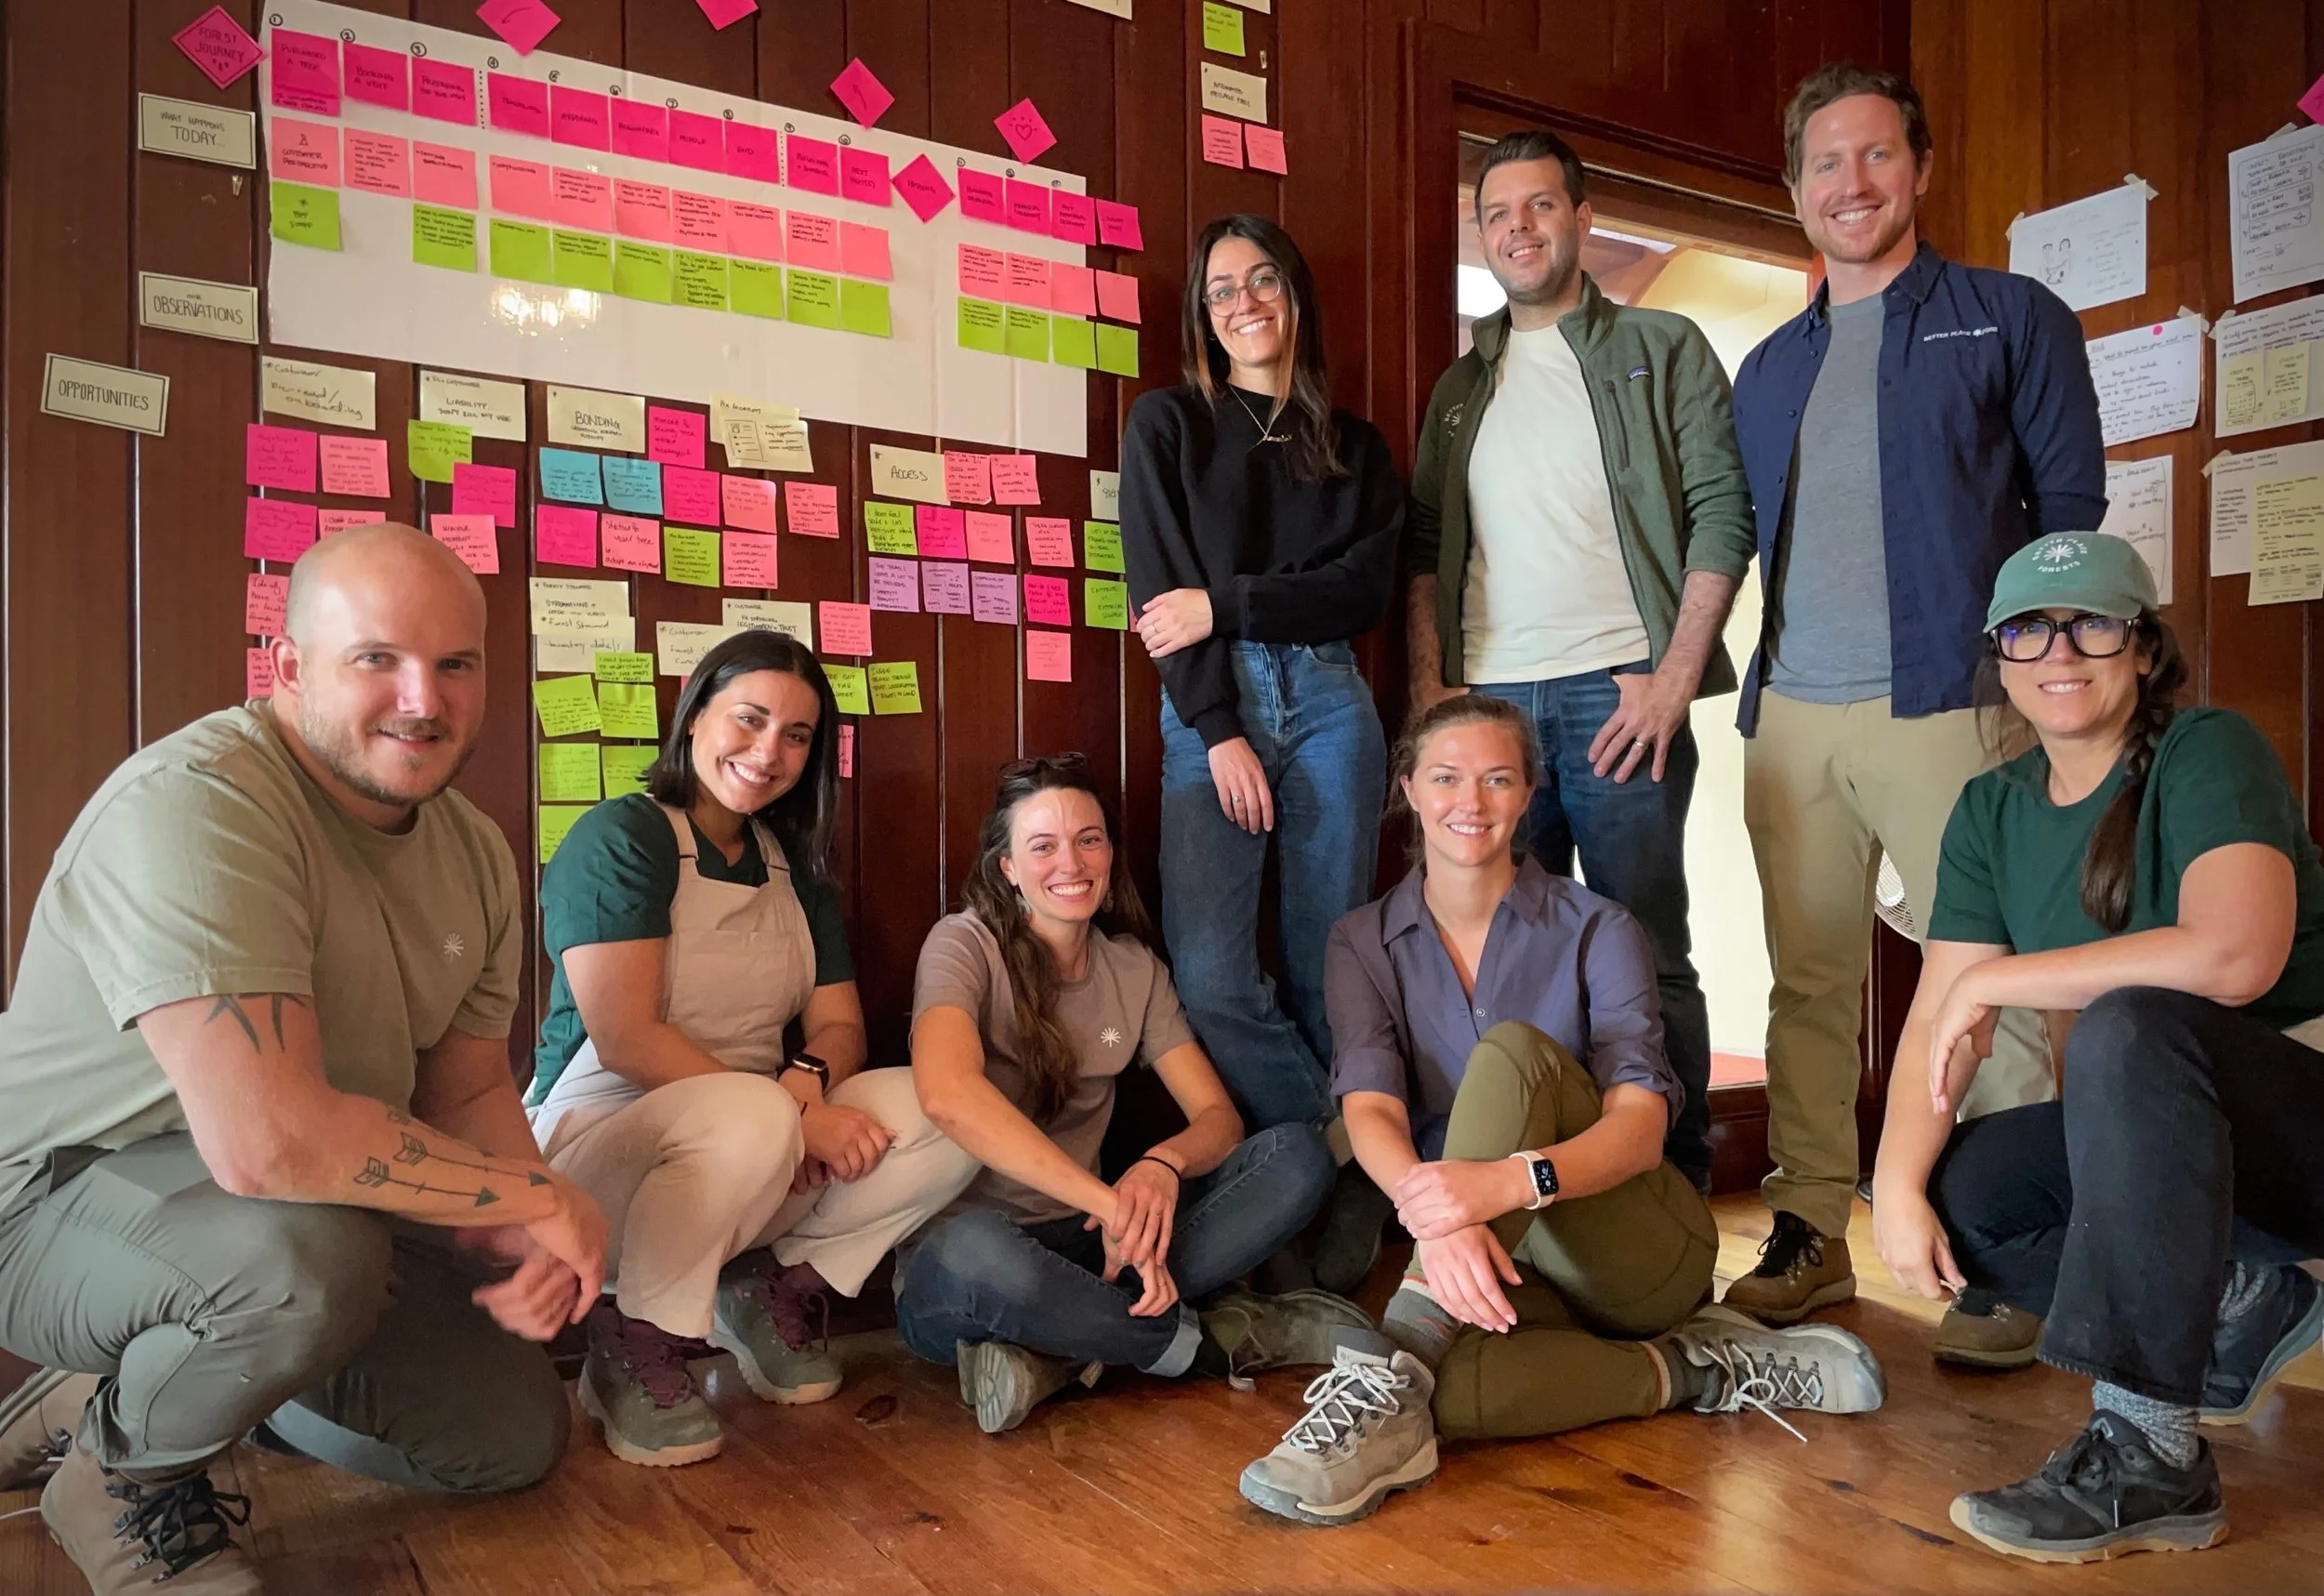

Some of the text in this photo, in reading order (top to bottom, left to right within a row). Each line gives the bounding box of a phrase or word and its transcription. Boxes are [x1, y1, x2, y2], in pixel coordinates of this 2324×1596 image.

[198, 26, 238, 45] FOREST
[195, 42, 246, 64] JOURNEY
[160, 111, 183, 125] WHAT
[736, 146, 755, 156] END
[153, 296, 244, 325] OBSERVATIONS
[58, 378, 150, 411] OPPORTUNITIES
[574, 410, 621, 430] BONDING
[891, 464, 929, 481] ACCESS
